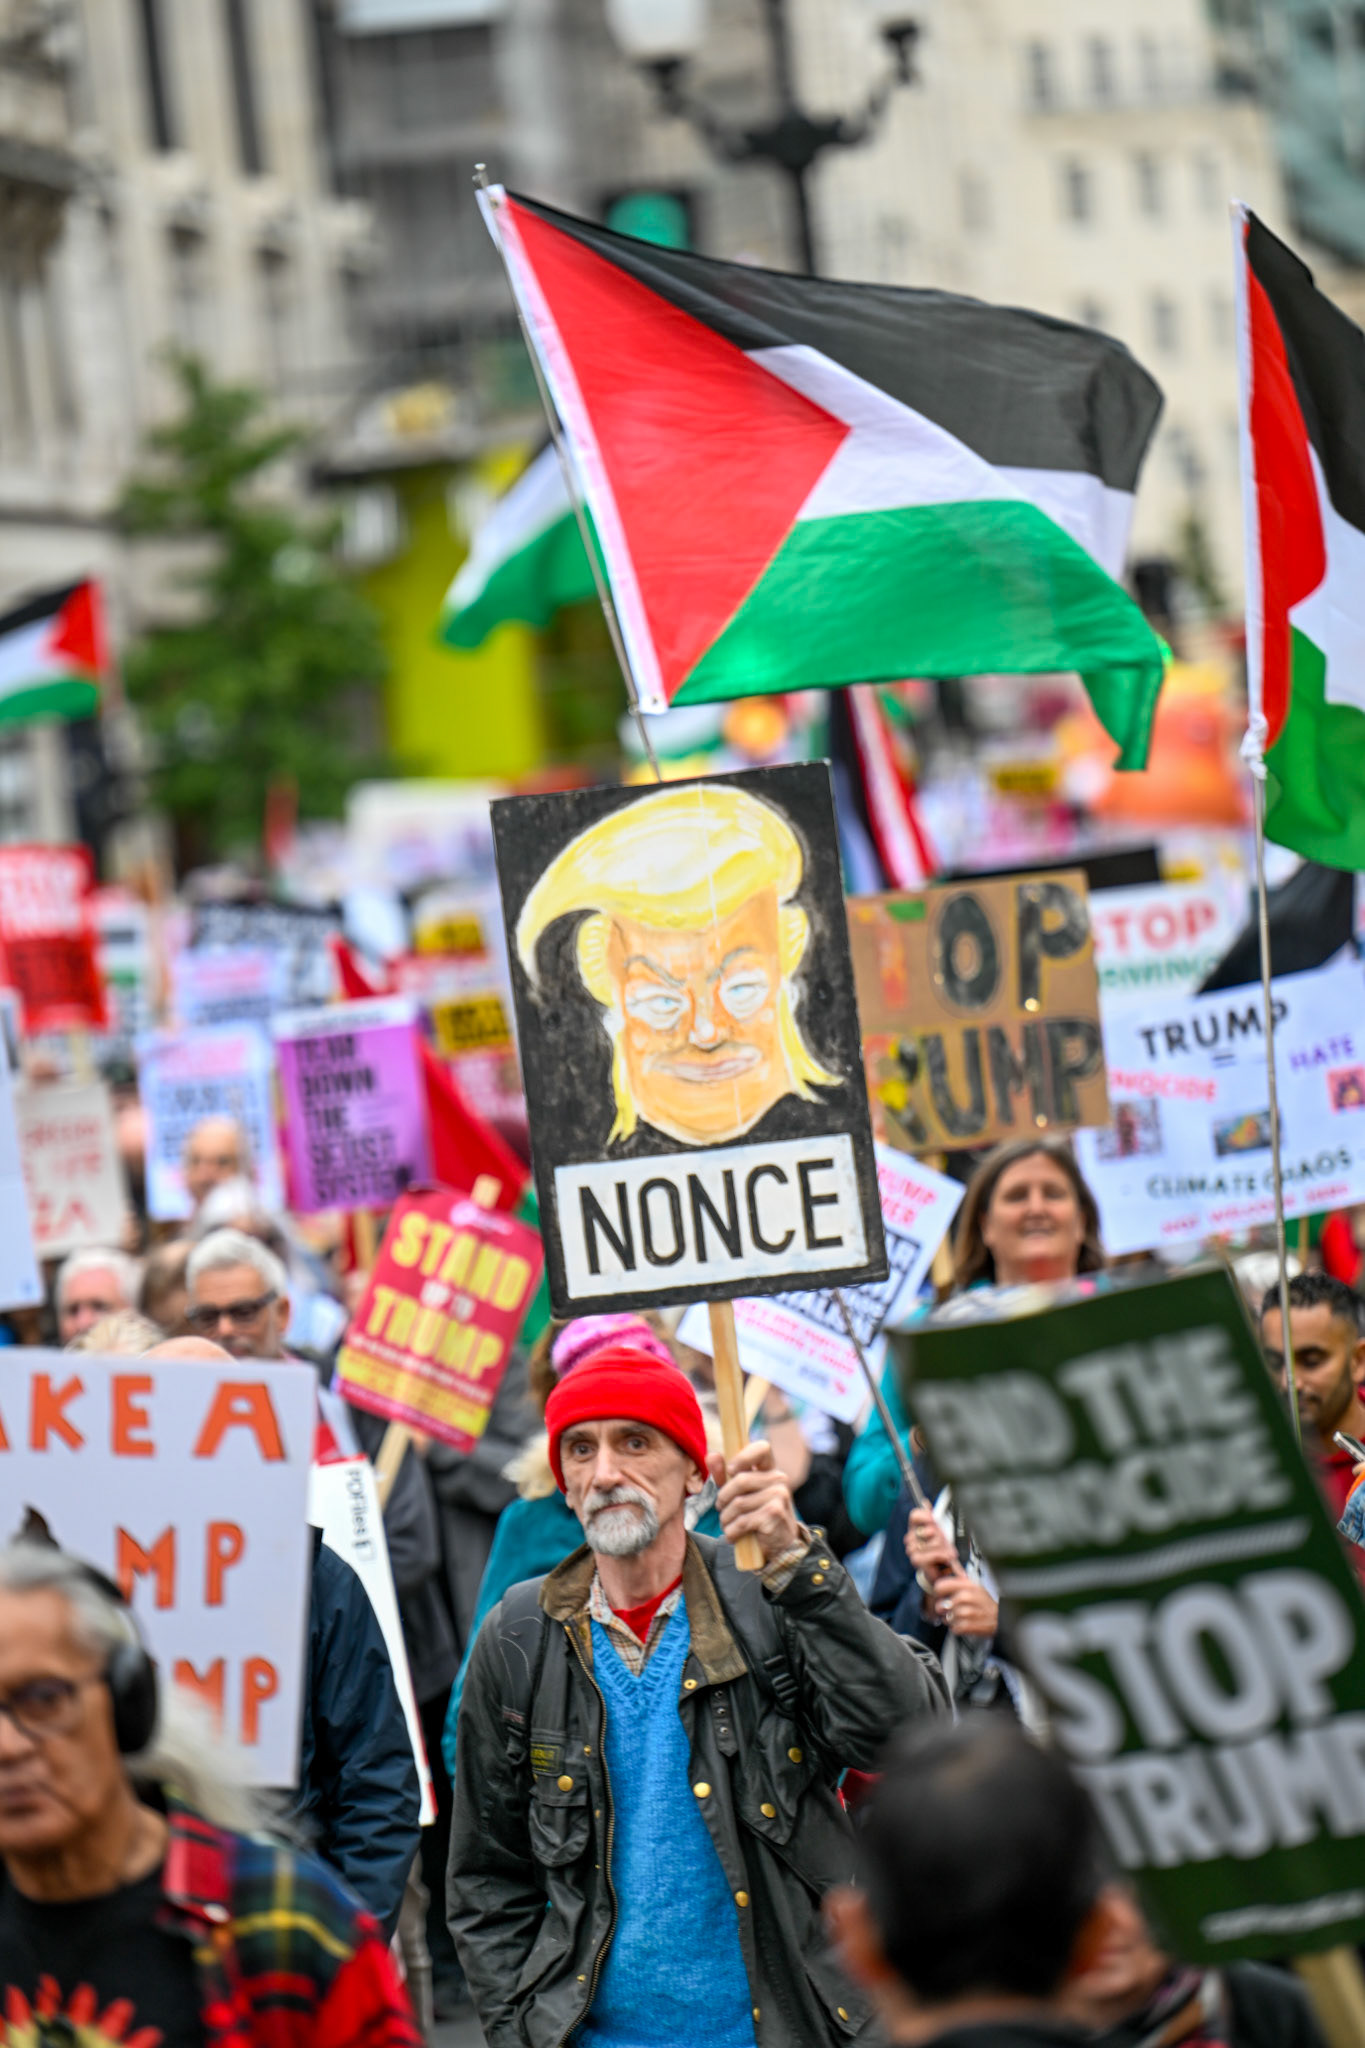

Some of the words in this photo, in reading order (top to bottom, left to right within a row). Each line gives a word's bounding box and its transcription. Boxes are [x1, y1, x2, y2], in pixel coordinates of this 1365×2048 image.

[1138, 1001, 1289, 1061] TRUMP
[1288, 1037, 1355, 1072] HATE
[1105, 1063, 1217, 1102] NOCIDE
[577, 1158, 843, 1276] NONCE
[1145, 1168, 1257, 1200] CLIMATE
[1261, 1144, 1353, 1191] CHAOS
[389, 1211, 533, 1313] STAND
[365, 1284, 504, 1380] TRUMP
[0, 1371, 156, 1457] KE
[192, 1380, 286, 1463] A
[1060, 1325, 1258, 1454] THE
[1018, 1566, 1356, 1760] STOP
